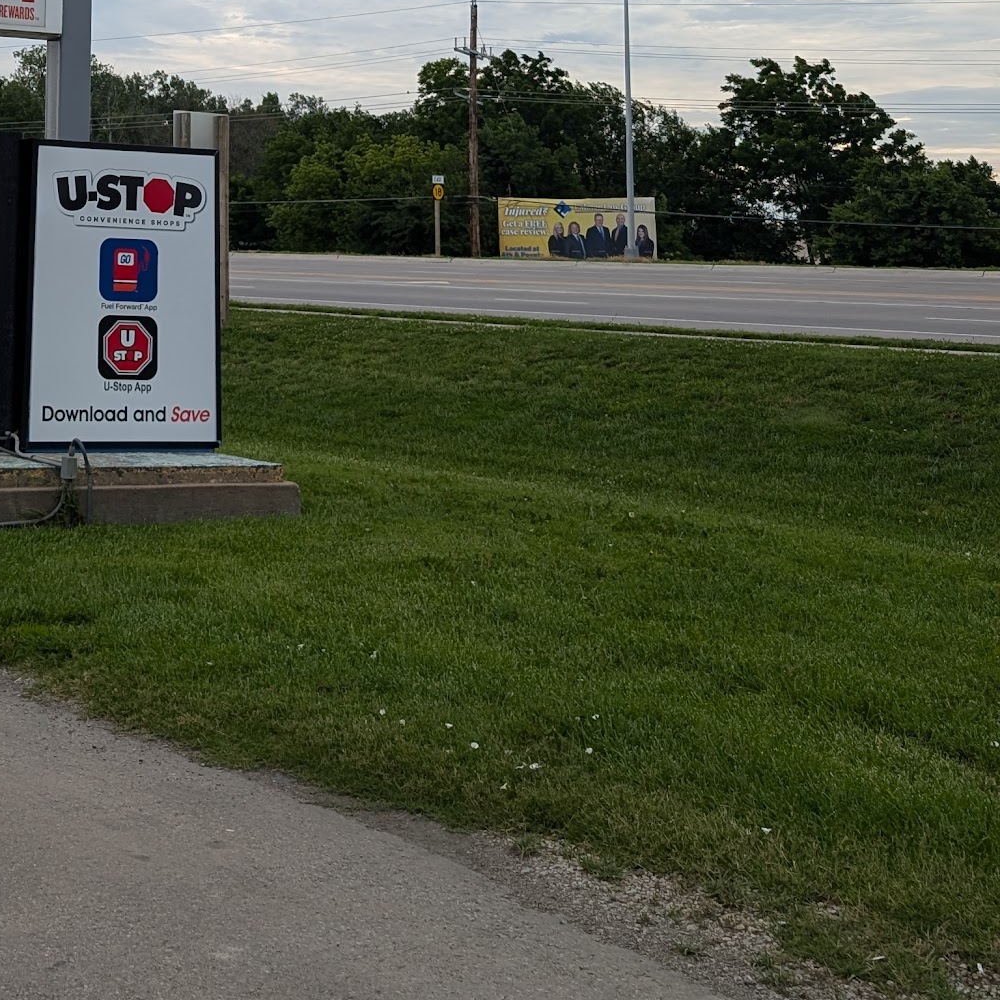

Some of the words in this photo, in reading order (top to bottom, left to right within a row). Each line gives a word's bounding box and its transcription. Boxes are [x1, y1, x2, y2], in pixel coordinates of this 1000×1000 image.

[504, 206, 549, 217] Injured?
[621, 203, 646, 212] Gup
[79, 215, 147, 226] CONVENIENCE
[150, 219, 181, 227] SHOPS
[502, 220, 517, 228] Get
[525, 220, 547, 228] FREE
[520, 228, 550, 236] review.
[120, 254, 132, 264] GO
[100, 302, 115, 310] Fuel
[144, 304, 158, 312] App
[120, 329, 136, 348] U
[103, 381, 133, 394] U-Stop
[134, 382, 152, 395] App
[42, 405, 131, 422] Download
[133, 405, 167, 422] and
[170, 406, 211, 423] Save
